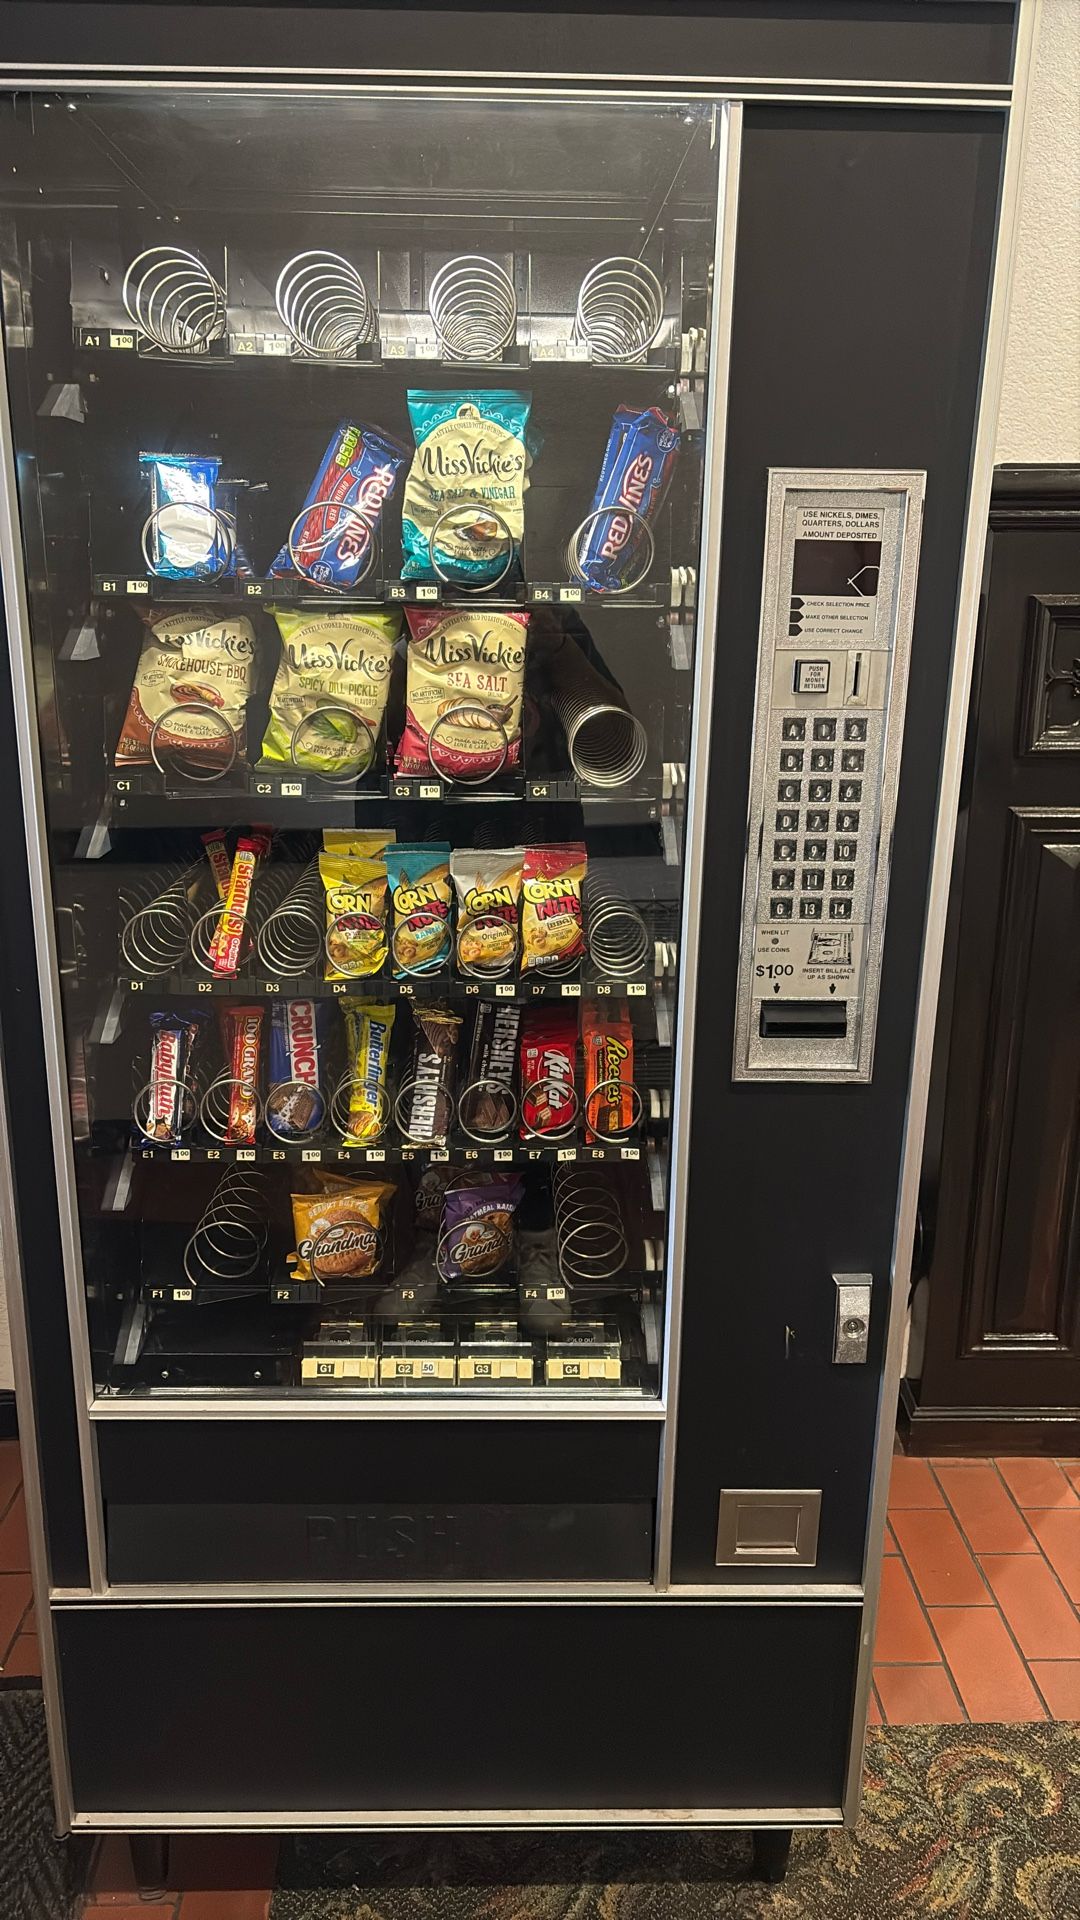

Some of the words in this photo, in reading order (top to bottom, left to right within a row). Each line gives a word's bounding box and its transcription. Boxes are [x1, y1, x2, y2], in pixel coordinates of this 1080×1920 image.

[85, 335, 100, 346] A1
[238, 341, 253, 352] A2
[389, 347, 405, 356] A3
[540, 348, 555, 358] A4
[422, 445, 467, 477] Miss
[459, 438, 524, 482] Vickie's
[481, 486, 516, 499] VINEGAR
[600, 514, 632, 561] RED
[618, 453, 653, 515] VINES
[820, 511, 854, 519] NICKELS,
[802, 519, 844, 528] QUARTERS,
[845, 520, 880, 528] DOLLARS
[103, 582, 116, 591] B1
[247, 586, 262, 595] B2
[391, 588, 405, 597] B3
[535, 590, 549, 599] B4
[425, 637, 471, 664] Miss
[289, 643, 334, 671] Miss
[325, 639, 392, 681] Vickie's
[157, 653, 222, 677] SMOKEHOUSE
[227, 665, 247, 683] BBQ
[299, 677, 325, 692] SPICY
[329, 682, 345, 695] DILL
[349, 683, 378, 697] PICKLE
[447, 673, 471, 689] SEA
[477, 675, 508, 693] SALT
[117, 782, 130, 790] C1
[257, 784, 272, 793] C2
[395, 787, 410, 796] C3
[532, 787, 547, 797] C4
[839, 846, 849, 857] 10
[807, 875, 817, 886] 11
[836, 875, 847, 886] 12
[523, 879, 574, 904] CORN
[326, 887, 372, 914] CORN
[394, 882, 437, 915] CORN
[465, 886, 512, 915] CORN
[537, 897, 580, 921] NUTS
[804, 904, 815, 915] 13
[834, 904, 845, 915] 14
[482, 930, 509, 940] Original
[228, 937, 241, 969] Original
[131, 982, 144, 990] D1
[198, 983, 212, 992] D2
[265, 984, 280, 992] D3
[333, 984, 347, 993] D4
[400, 985, 413, 993] D5
[466, 986, 479, 994] D6
[533, 987, 546, 995] D7
[597, 986, 611, 994] D8
[245, 1017, 260, 1044] 100
[289, 1001, 316, 1085] CRUNCH
[157, 1031, 177, 1077] Baby
[486, 1005, 520, 1095] HERSHEY'S
[364, 1020, 387, 1108] Butterfinger
[543, 1051, 570, 1081] Kit
[241, 1045, 258, 1100] GRAND
[606, 1036, 629, 1107] Reese's
[408, 1053, 442, 1137] HERSHEY'S
[543, 1077, 569, 1110] Kat
[208, 1151, 220, 1159] E2
[338, 1151, 351, 1159] E4
[466, 1151, 478, 1159] E6
[529, 1151, 542, 1159] E7
[592, 1150, 605, 1158] E8
[152, 1290, 164, 1298] F1
[277, 1291, 290, 1299] F2
[402, 1291, 414, 1299] F3
[525, 1290, 537, 1298] F4
[320, 1365, 332, 1373] G1
[476, 1365, 489, 1373] G3
[565, 1365, 578, 1373] G4
